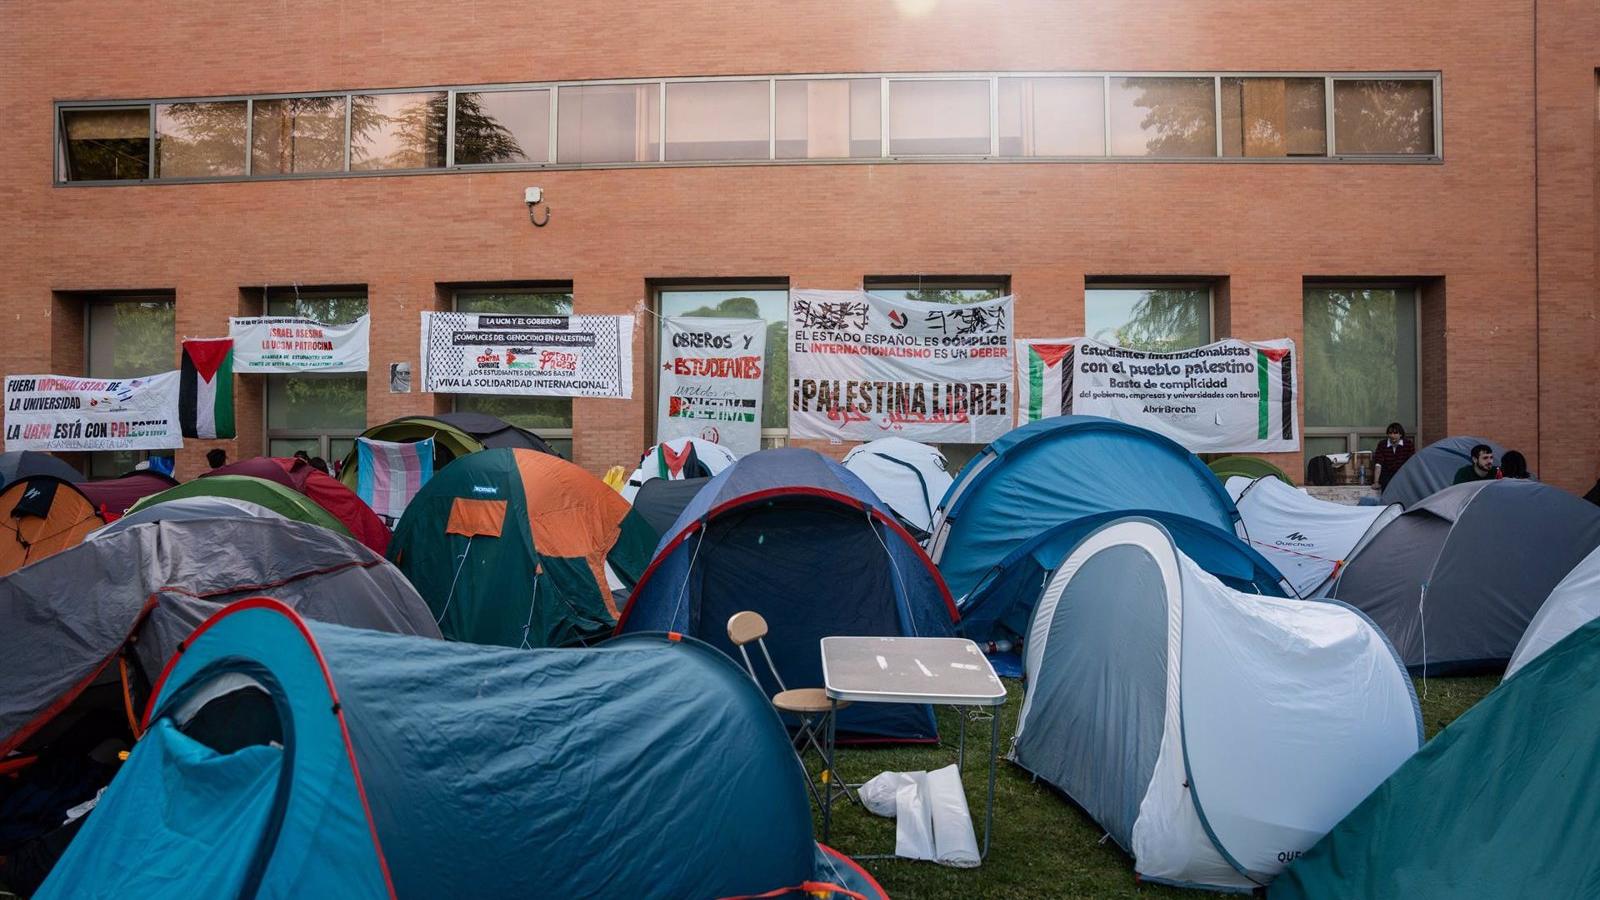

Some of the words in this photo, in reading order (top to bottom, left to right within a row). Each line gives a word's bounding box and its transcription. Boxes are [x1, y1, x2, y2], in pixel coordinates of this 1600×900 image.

[527, 318, 561, 326] GOBIERNO
[295, 340, 333, 351] PATROCINA
[494, 334, 506, 342] DEL
[507, 333, 544, 342] GENOCIDIO
[545, 334, 555, 342] EN
[555, 334, 594, 343] PALESTINA!
[672, 332, 733, 349] OBREROS
[743, 334, 754, 350] Y
[795, 330, 809, 341] EL
[812, 331, 861, 343] ESTADO
[865, 333, 924, 346] ESPAÑOL
[925, 336, 939, 347] ES
[942, 334, 1007, 347] CÓMPLICE
[795, 342, 808, 353] EL
[810, 343, 931, 358] INTERNACIONALISMO
[934, 348, 950, 359] ES
[951, 348, 968, 359] UN
[970, 347, 1008, 358] DEBER
[1080, 344, 1146, 360] Estudiantes
[484, 369, 524, 377] ESTUDIANTES
[674, 355, 761, 380] ESTUDIANTES
[1080, 362, 1108, 374] con
[1112, 361, 1127, 375] el
[1130, 362, 1181, 377] pueblo
[1185, 361, 1255, 378] palestino
[7, 379, 36, 393] FUERA
[37, 378, 106, 392] IMPERIALISTAS
[106, 381, 122, 392] DE
[435, 379, 459, 389] ¡VIVA
[461, 379, 473, 388] LA
[474, 379, 533, 389] SOLIDARIDAD
[534, 380, 609, 390] INTERNACIONAL!
[1109, 378, 1141, 389] Basta
[1143, 378, 1158, 389] de
[1159, 378, 1228, 391] complicidad
[9, 397, 21, 411] LA
[23, 396, 81, 410] UNIVERSIDAD
[793, 379, 927, 415] ¡PALESTINA
[932, 383, 1007, 416] LIBRE!
[1079, 391, 1091, 399] del
[1093, 391, 1128, 401] gobierno,
[1130, 392, 1167, 401] empresas
[1167, 393, 1173, 401] y
[1173, 391, 1225, 400] universidades
[1239, 391, 1260, 399] Israel
[1142, 404, 1197, 414] AbrirBrecha
[6, 424, 21, 440] LA
[23, 423, 50, 439] UAM
[53, 419, 81, 439] ESTÁ
[84, 422, 108, 439] CON
[1275, 540, 1314, 548] Quechua
